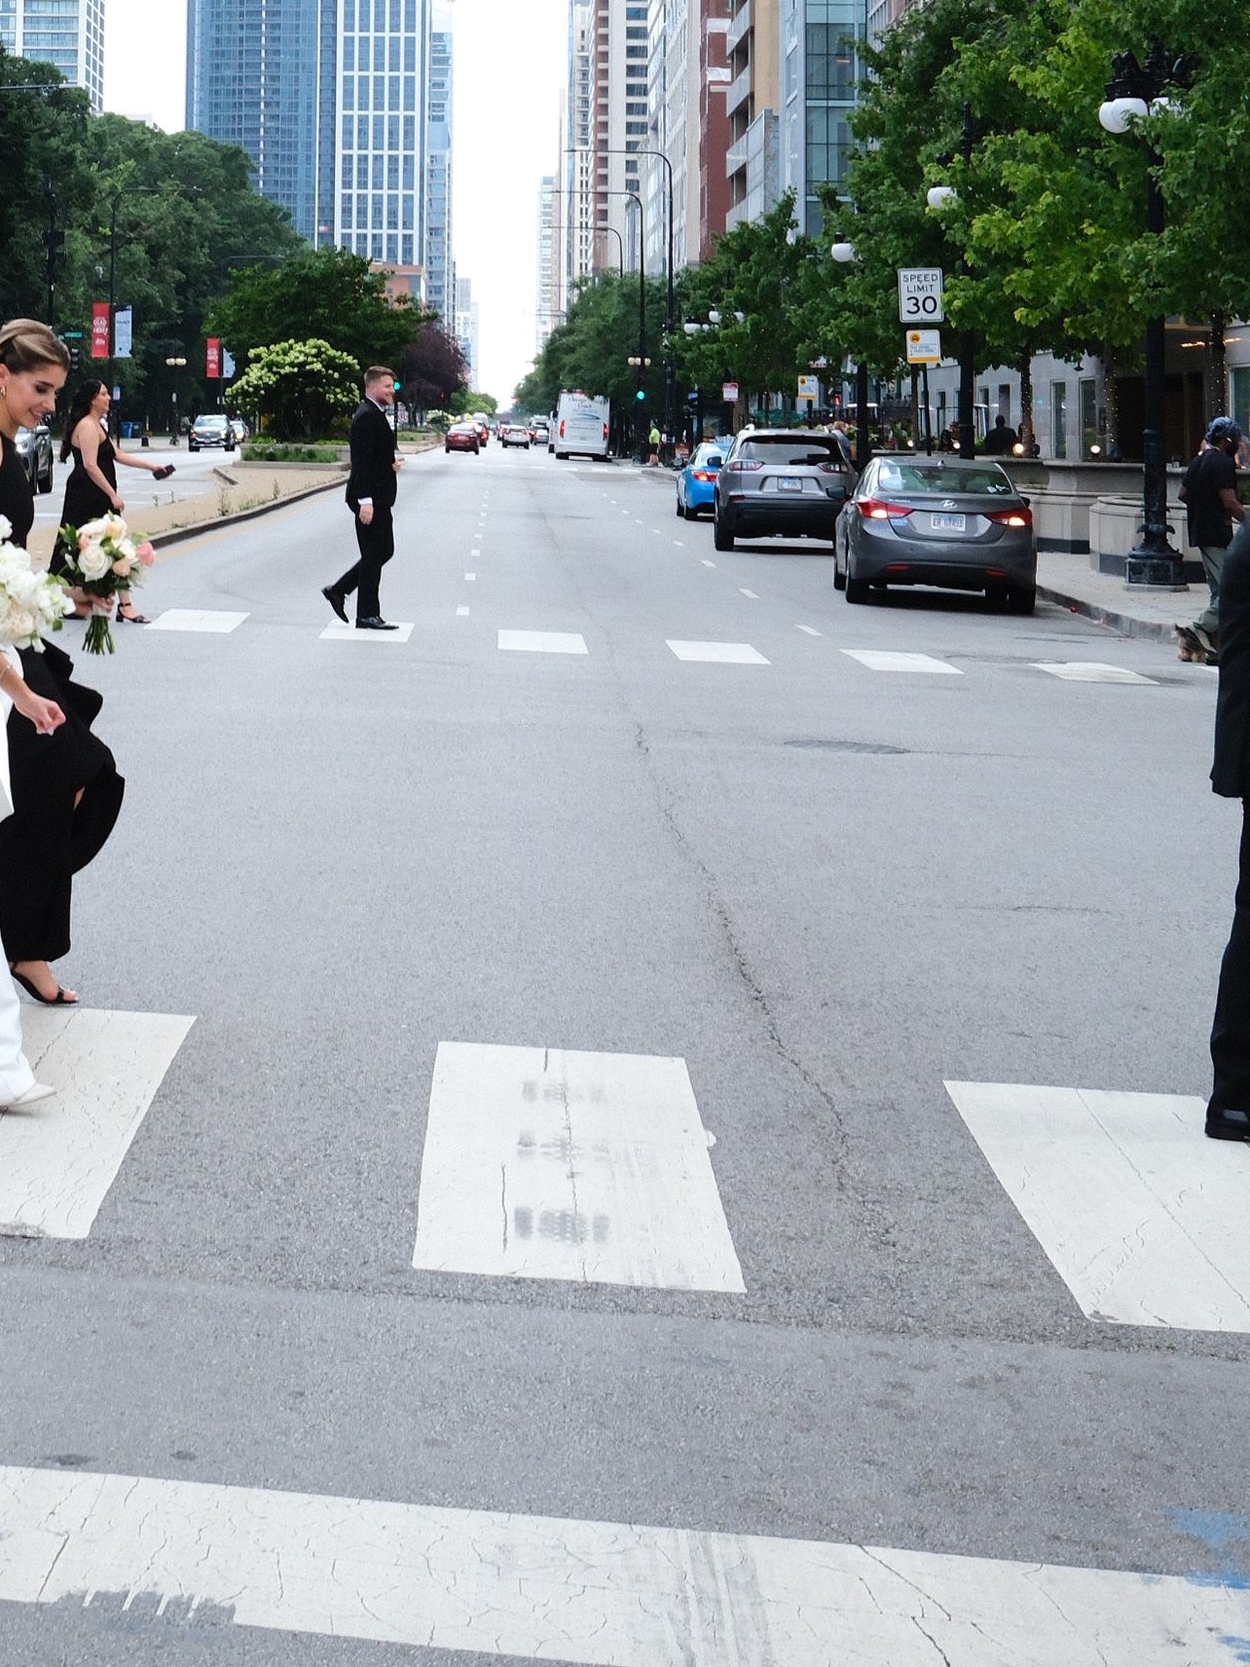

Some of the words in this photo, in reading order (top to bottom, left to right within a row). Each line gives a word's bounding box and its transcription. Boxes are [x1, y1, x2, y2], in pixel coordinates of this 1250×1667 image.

[903, 273, 938, 282] SPEED
[906, 284, 934, 293] LIMIT
[906, 295, 937, 314] 30
